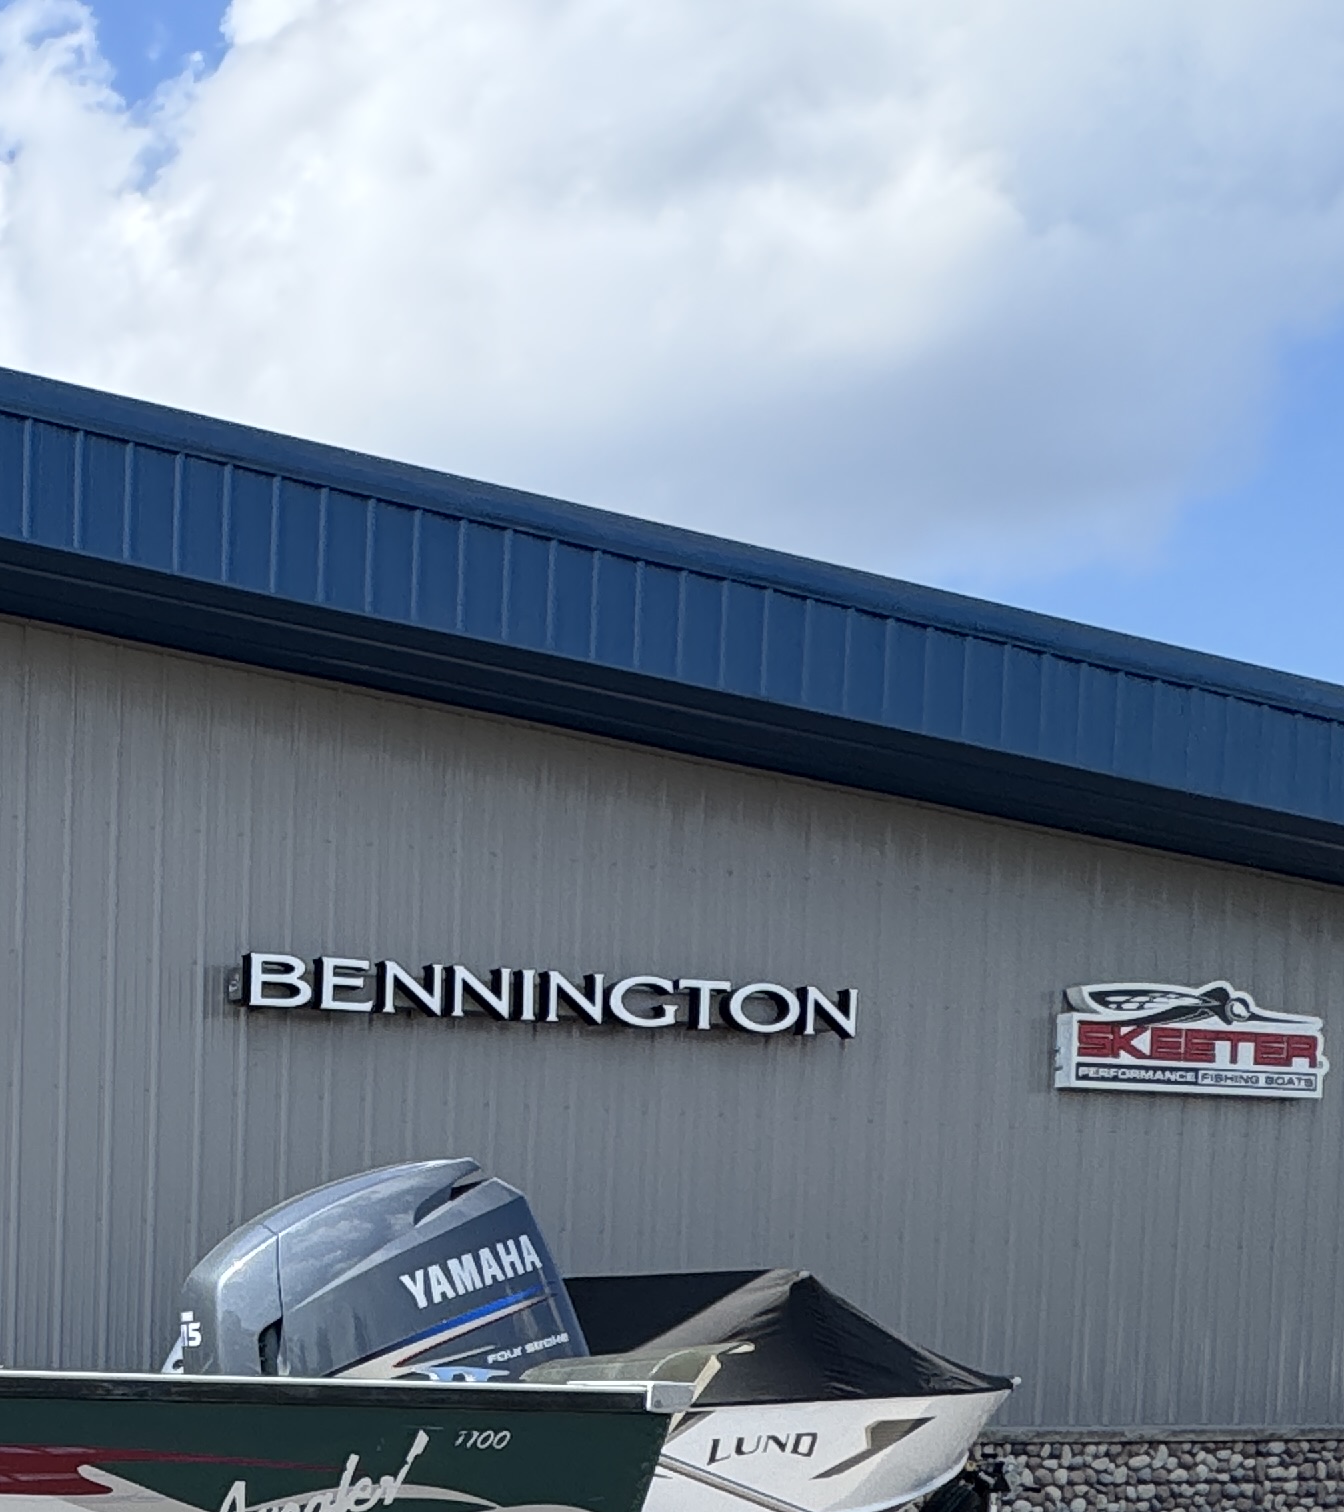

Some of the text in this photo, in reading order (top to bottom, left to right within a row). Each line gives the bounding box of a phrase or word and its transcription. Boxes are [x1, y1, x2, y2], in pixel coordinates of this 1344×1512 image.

[244, 951, 860, 1040] BENNINGTON
[1077, 1020, 1318, 1068] SKEETER
[1078, 1066, 1313, 1087] PERFORMANCE FISHING BOATS
[399, 1234, 543, 1310] YAMAHA
[707, 1432, 818, 1466] LUND
